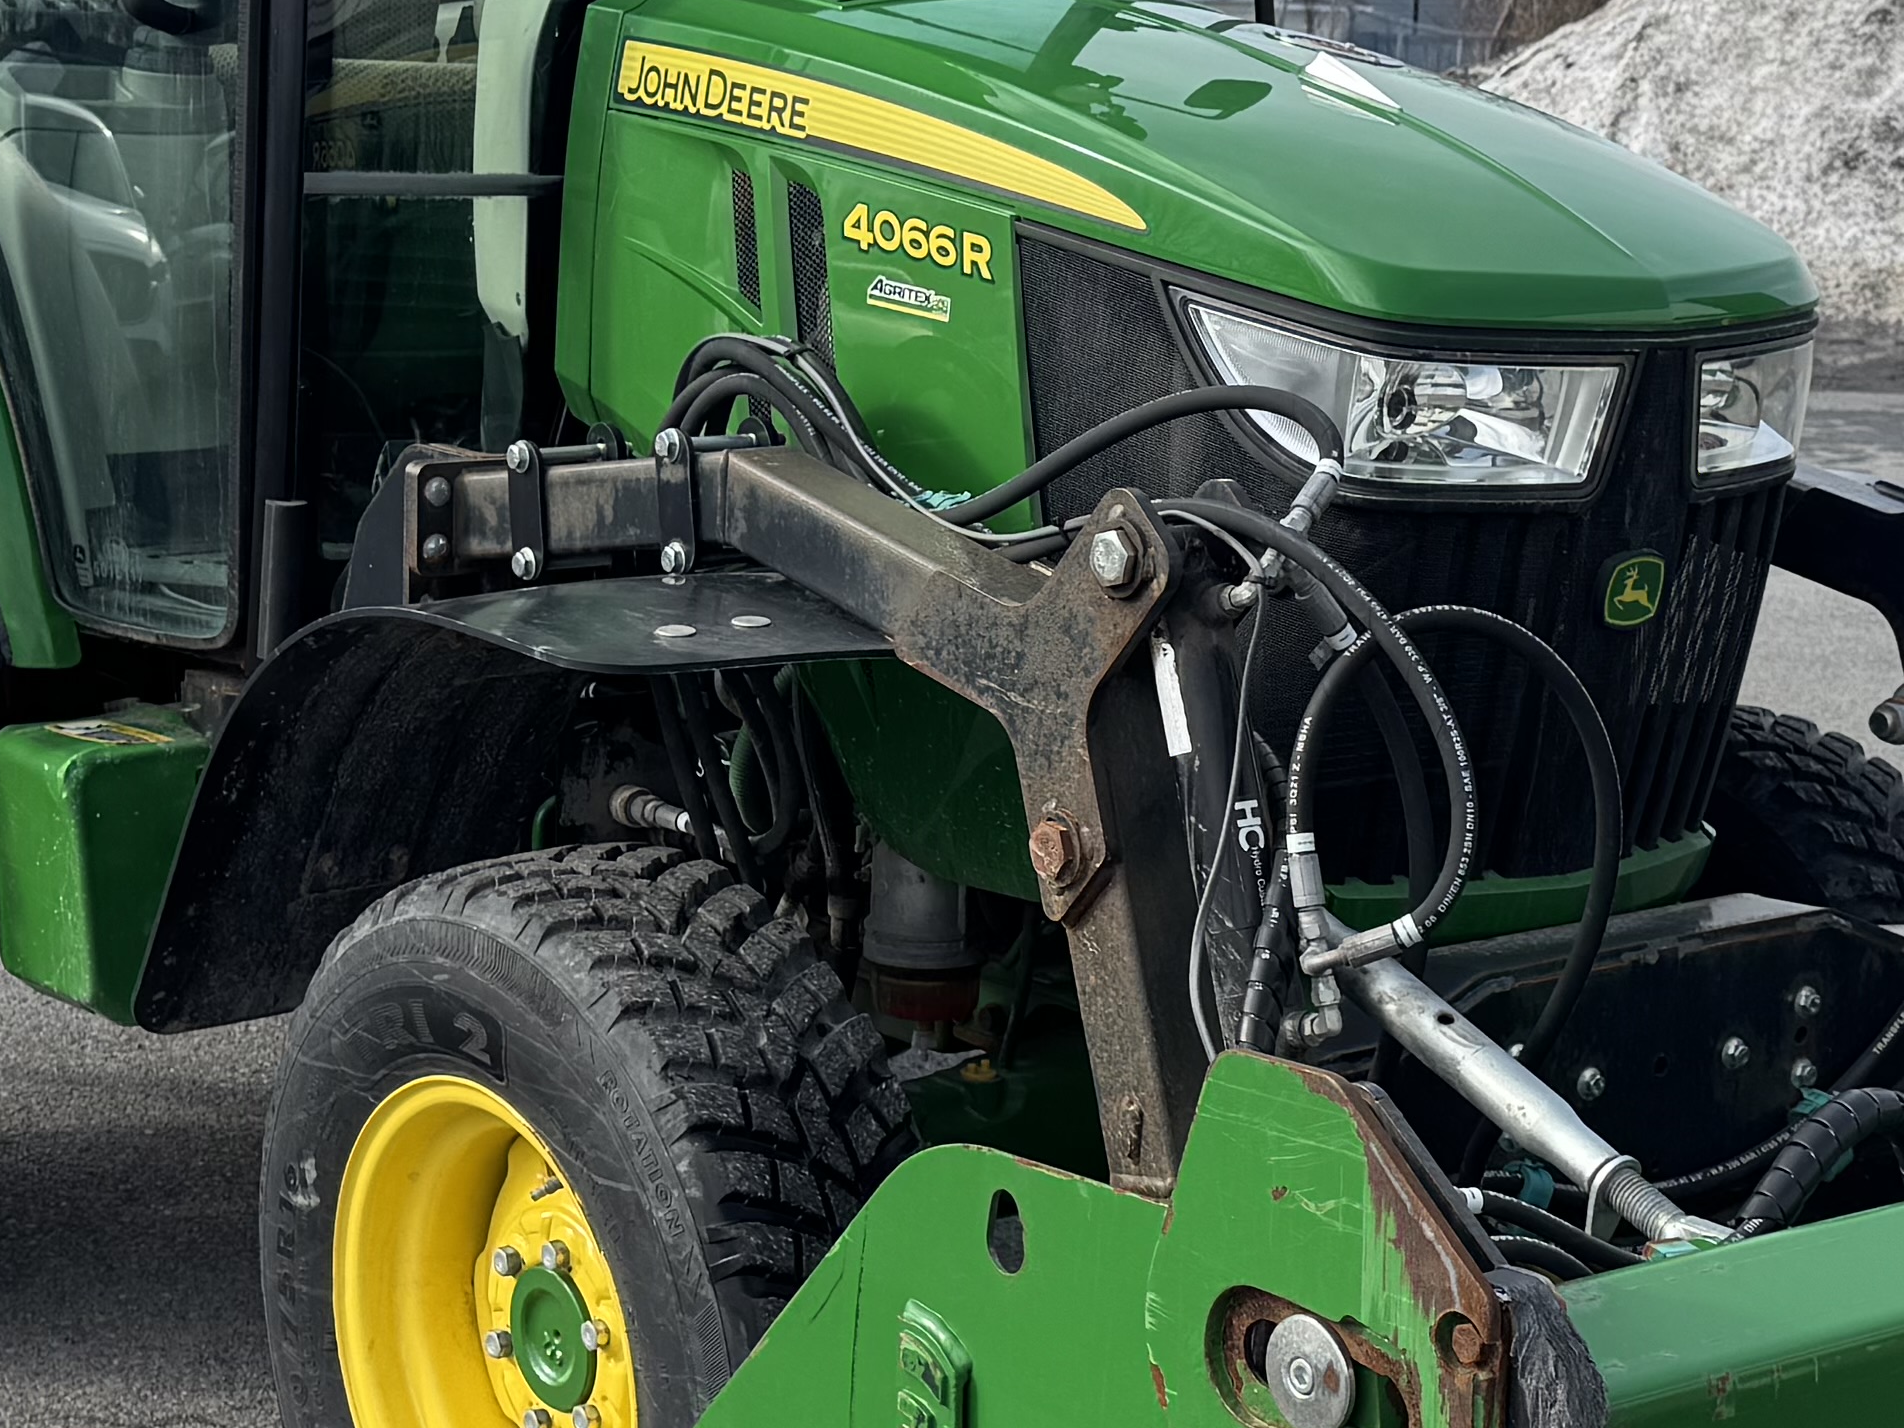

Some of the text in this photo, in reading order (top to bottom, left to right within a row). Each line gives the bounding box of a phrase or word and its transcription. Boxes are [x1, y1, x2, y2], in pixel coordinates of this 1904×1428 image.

[627, 55, 811, 133] JOHN DEERE
[870, 278, 933, 306] AGRITEX
[1234, 799, 1265, 852] HC
[453, 1012, 493, 1066] 2
[598, 1069, 686, 1239] ROTATION
